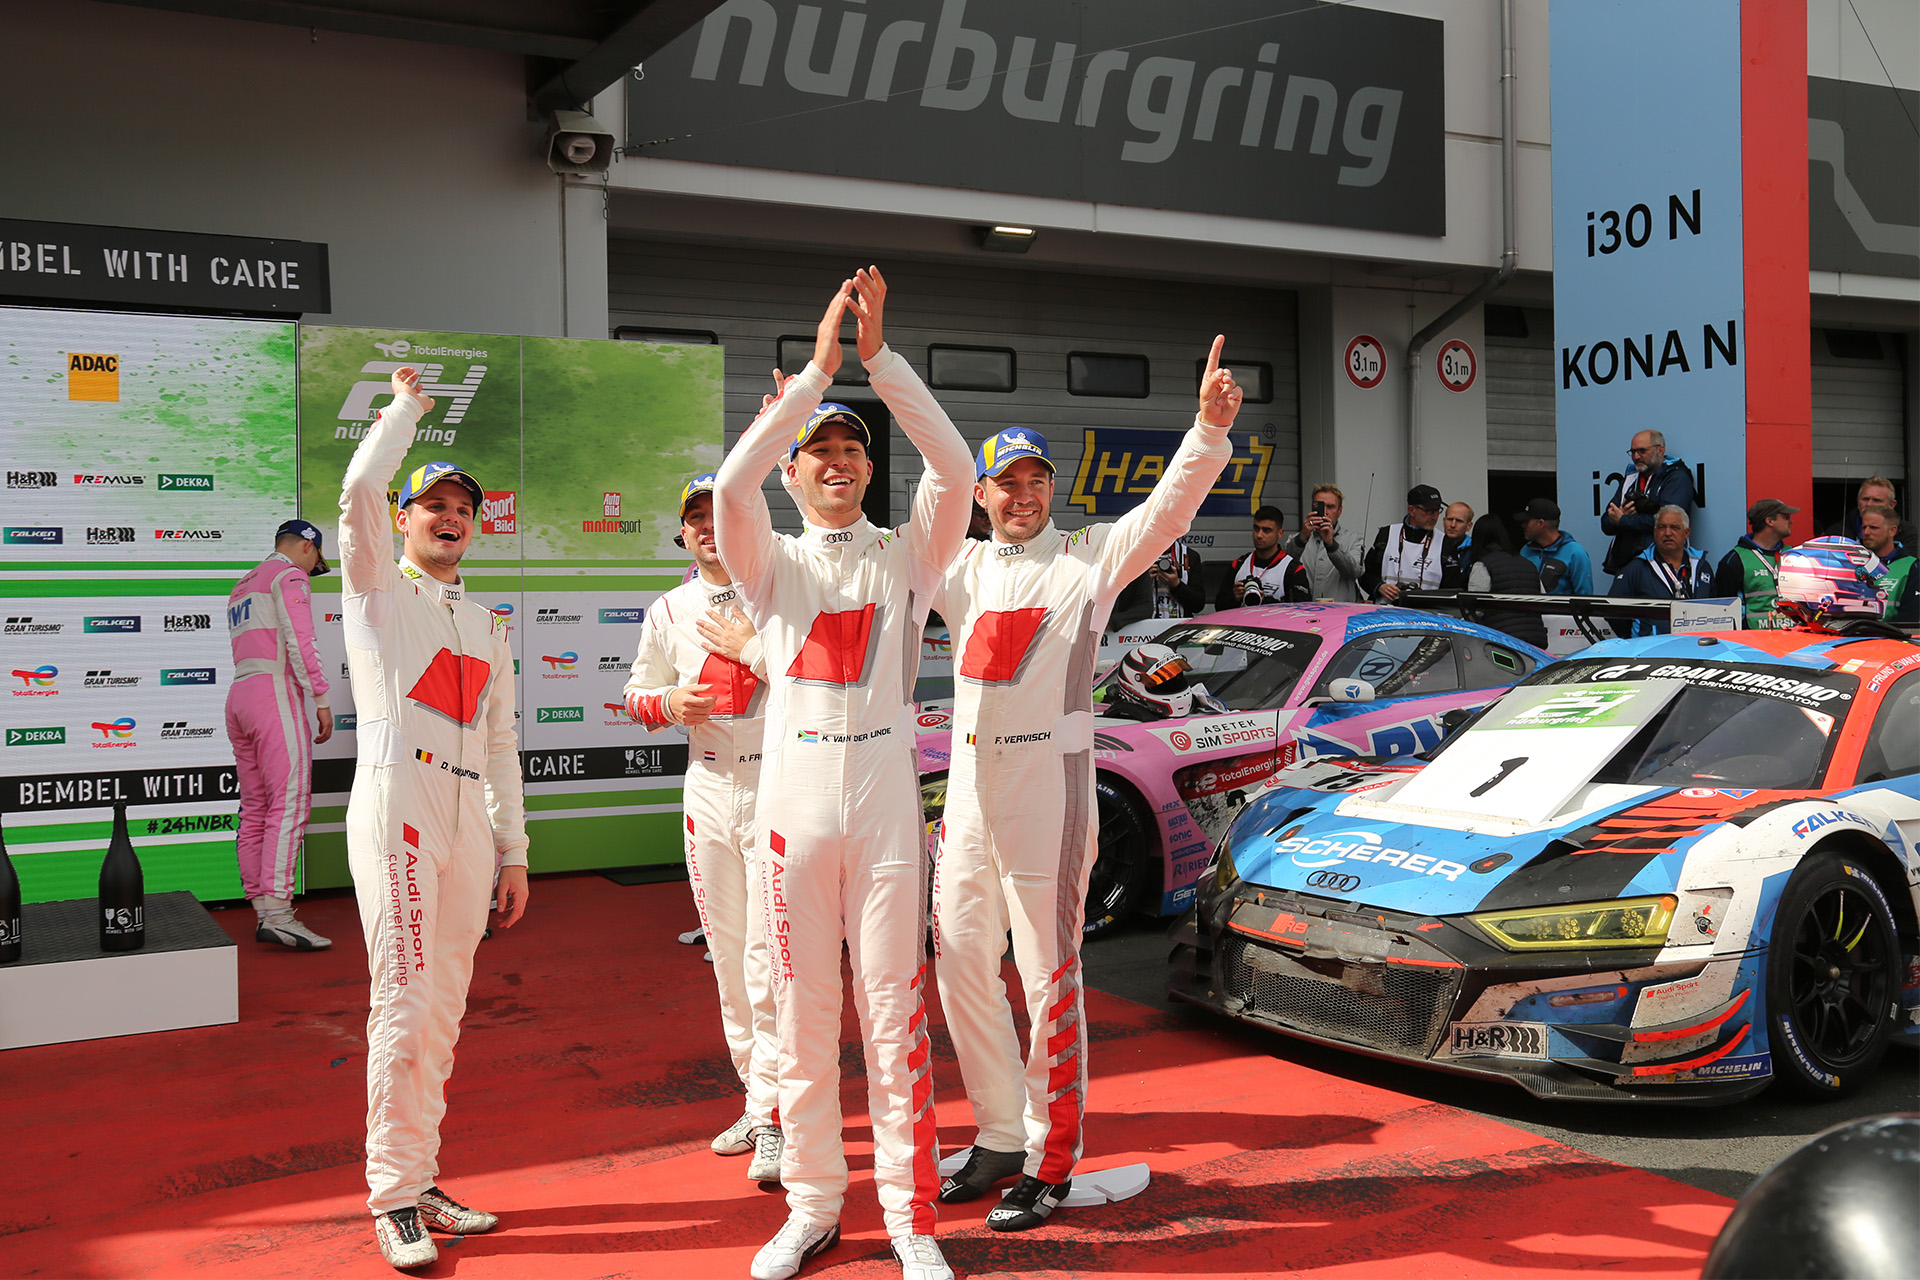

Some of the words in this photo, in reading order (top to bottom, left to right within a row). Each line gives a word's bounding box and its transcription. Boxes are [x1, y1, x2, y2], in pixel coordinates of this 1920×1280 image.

[1587, 203, 1652, 258] i30
[1668, 188, 1701, 240] N
[104, 248, 188, 283] WITH
[210, 257, 300, 290] CARE
[412, 345, 488, 359] TotalEnergies
[1562, 329, 1690, 390] KONA
[1703, 320, 1737, 370] N
[70, 355, 117, 373] ADAC
[997, 444, 1042, 458] MICHELIN
[7, 471, 38, 486] H&R
[82, 475, 144, 484] REMUS
[176, 477, 210, 488] DEKRA
[482, 493, 515, 522] Sport
[603, 493, 620, 506] Auto
[604, 505, 620, 517] Bild
[494, 519, 514, 532] Bild
[582, 518, 641, 534] motorsport
[87, 527, 116, 541] H&R
[162, 530, 222, 539] REMUS
[164, 615, 193, 629] H&R
[554, 614, 582, 622] TURISMO
[4, 624, 26, 632] GRAN
[27, 624, 61, 632] TURISMO
[1225, 631, 1289, 651] TURISMO
[1236, 643, 1273, 657] SIMULATOR
[84, 677, 105, 685] GRAN
[106, 677, 139, 685] TURISMO
[1650, 665, 1724, 682] GRAN
[1719, 670, 1840, 701] TURISMO
[1698, 680, 1748, 692] DRIVING
[1748, 686, 1821, 708] SIMULATOR
[552, 709, 581, 719] DEKRA
[161, 729, 182, 737] GRAN
[183, 728, 214, 736] TURISMO
[853, 733, 869, 742] DER
[870, 727, 892, 739] LINDE
[1204, 720, 1256, 734] ASETEK
[26, 730, 62, 741] DEKRA
[995, 736, 1002, 745] F.
[1004, 731, 1051, 744] VERVISCH
[1195, 735, 1222, 749] SIM
[1224, 727, 1276, 745] SPORTS
[441, 761, 449, 771] D.
[529, 754, 585, 776] CARE
[1219, 756, 1281, 783] TotalEnergies
[1469, 756, 1529, 798] 1
[20, 778, 128, 805] BEMBEL
[143, 774, 203, 799] WITH
[147, 815, 234, 834] #24hNBR
[1792, 811, 1881, 840] FALKEN
[1275, 836, 1468, 882] SCHERER
[405, 851, 421, 902] Audi
[688, 840, 703, 882] Audi
[696, 887, 712, 939] Sport
[772, 860, 787, 913] Audi
[389, 854, 403, 931] customer
[396, 936, 409, 986] racing
[933, 901, 942, 960] Sport
[409, 908, 425, 972] Sport
[776, 919, 794, 982] Sport
[1656, 986, 1675, 995] Audi
[1676, 981, 1699, 992] Sport
[1455, 1025, 1508, 1051] H&R
[1698, 1062, 1762, 1075] MICHELIN
